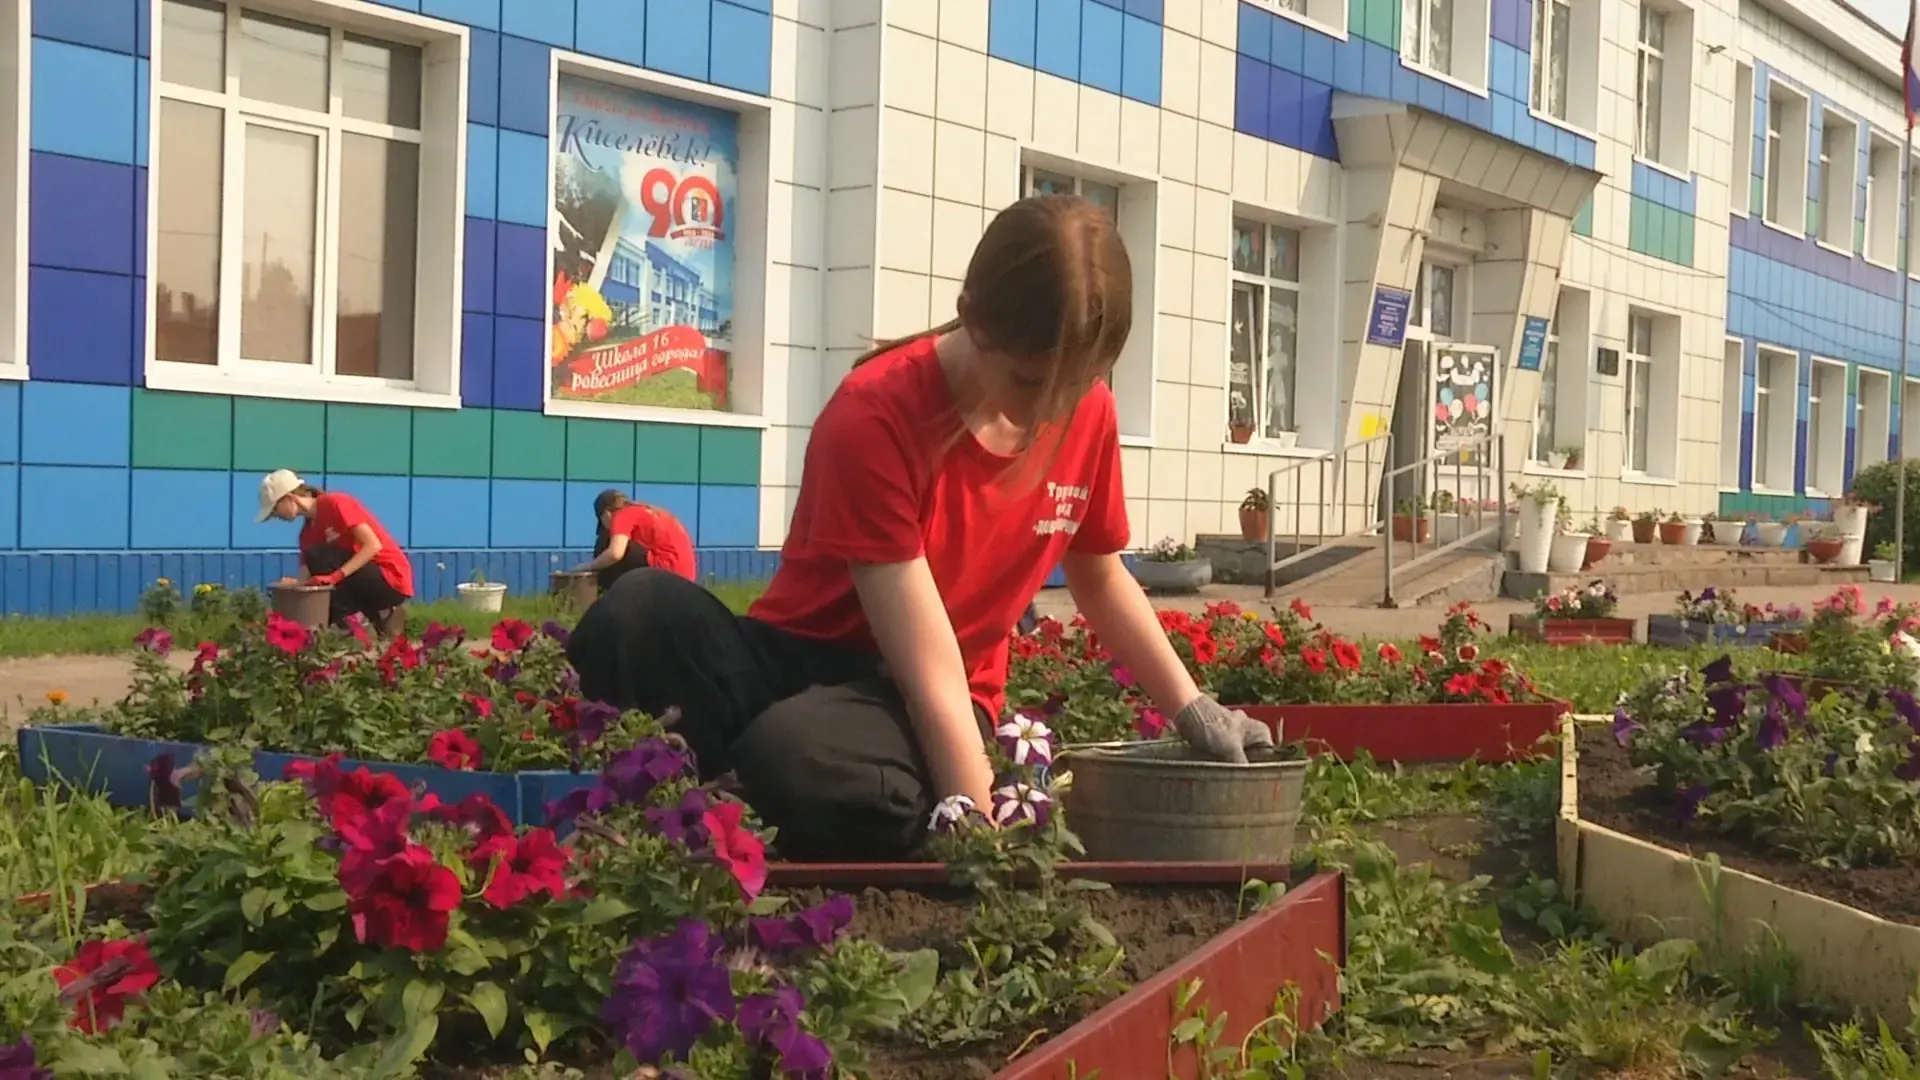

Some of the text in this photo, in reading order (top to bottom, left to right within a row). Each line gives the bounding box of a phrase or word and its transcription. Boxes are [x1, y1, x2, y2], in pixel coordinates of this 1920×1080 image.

[640, 168, 724, 238] 90
[571, 358, 648, 391] ровесница
[591, 332, 670, 376] Школа 16
